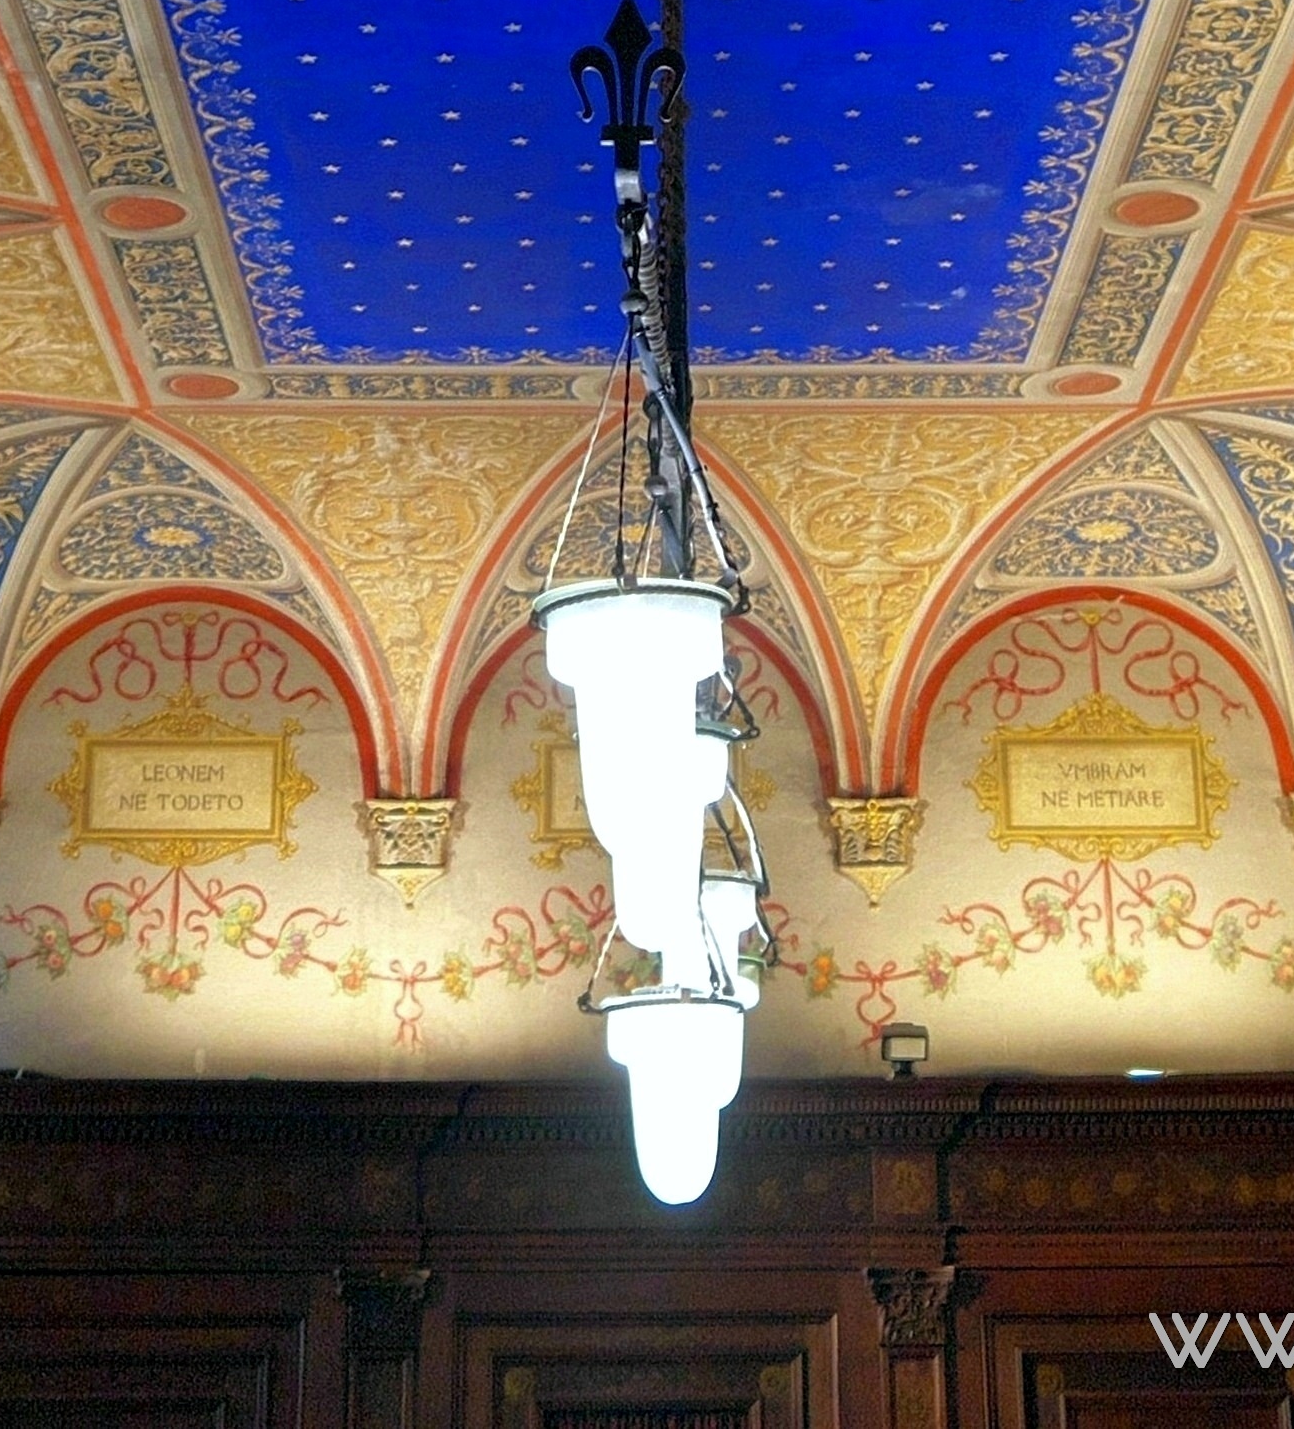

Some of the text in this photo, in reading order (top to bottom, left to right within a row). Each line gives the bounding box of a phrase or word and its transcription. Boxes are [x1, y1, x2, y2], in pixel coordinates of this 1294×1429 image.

[141, 764, 225, 783] LEONEM
[1058, 762, 1146, 781] VMBRAM
[118, 793, 244, 812] NE TODETO
[1041, 790, 1165, 809] NE METIARE
